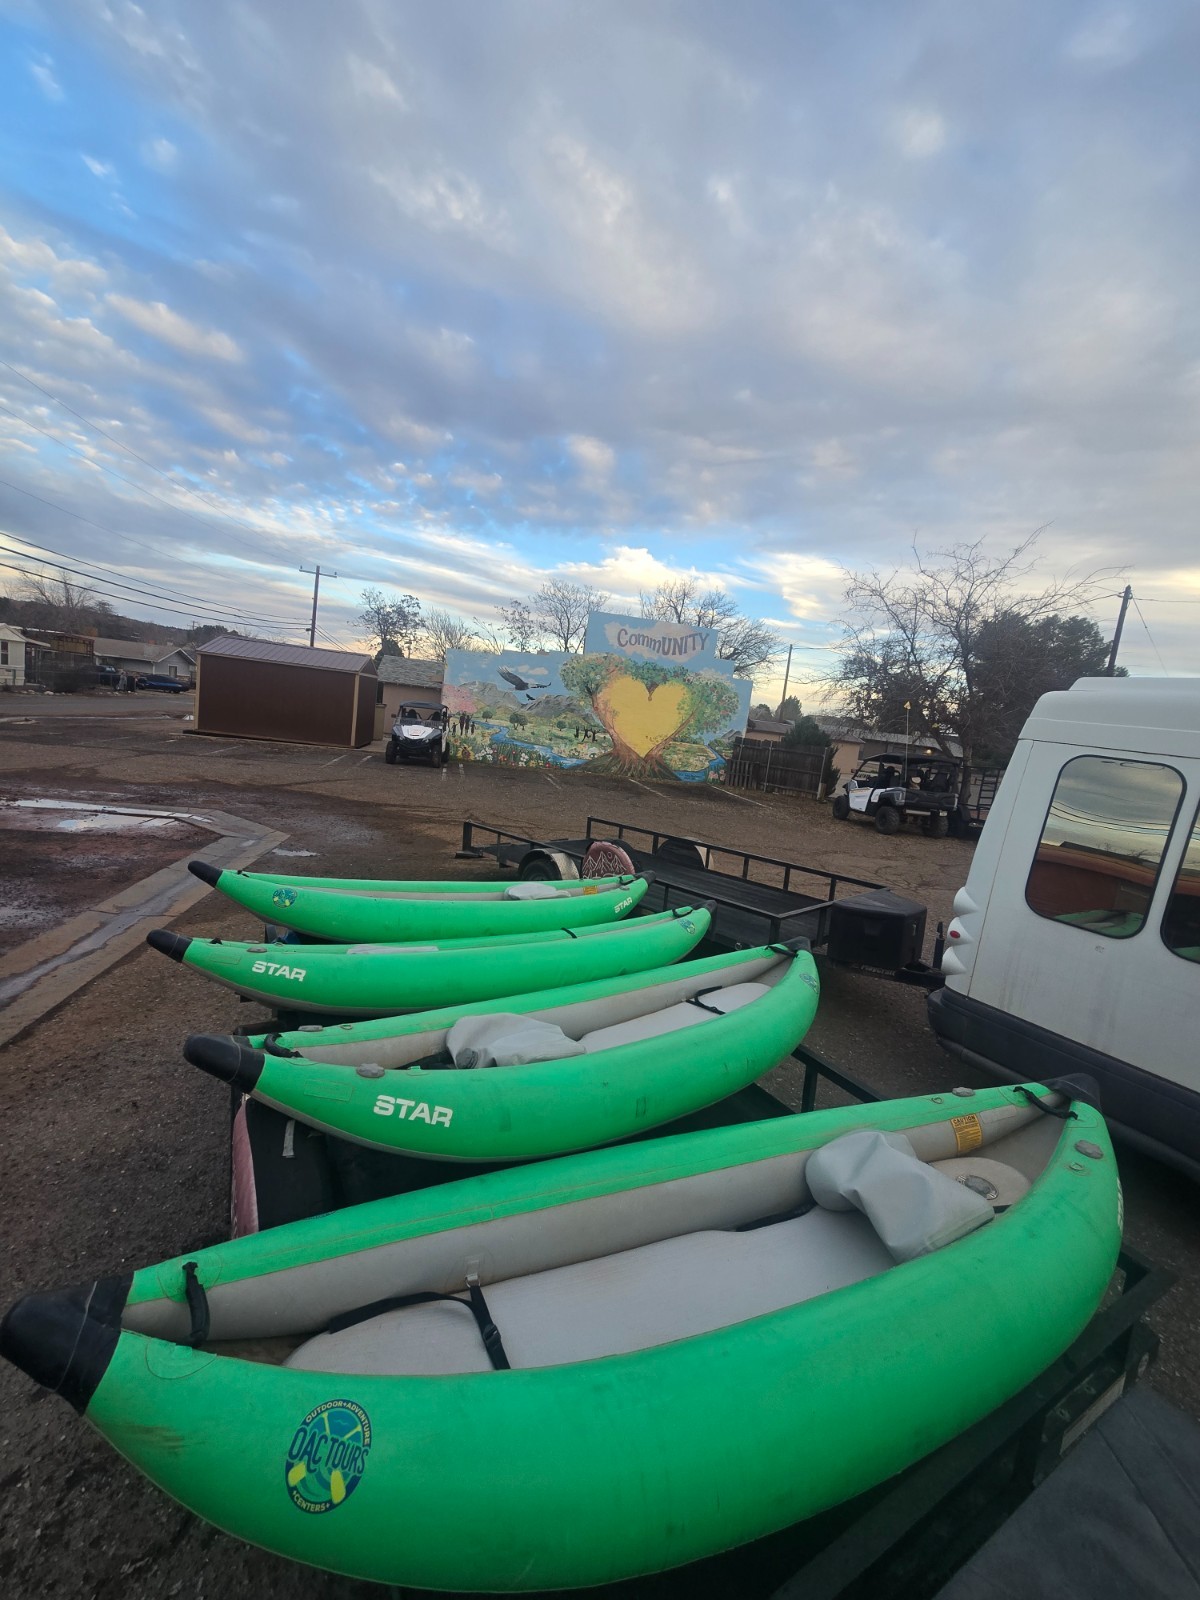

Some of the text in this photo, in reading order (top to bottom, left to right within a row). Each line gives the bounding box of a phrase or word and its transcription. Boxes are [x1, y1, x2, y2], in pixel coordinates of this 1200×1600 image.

[617, 628, 710, 656] CommUNITY
[613, 896, 633, 914] STAR
[251, 960, 307, 982] STAR
[372, 1094, 454, 1127] STAR
[288, 1426, 369, 1474] OAC TOURS
[293, 1492, 326, 1512] CENTERS
